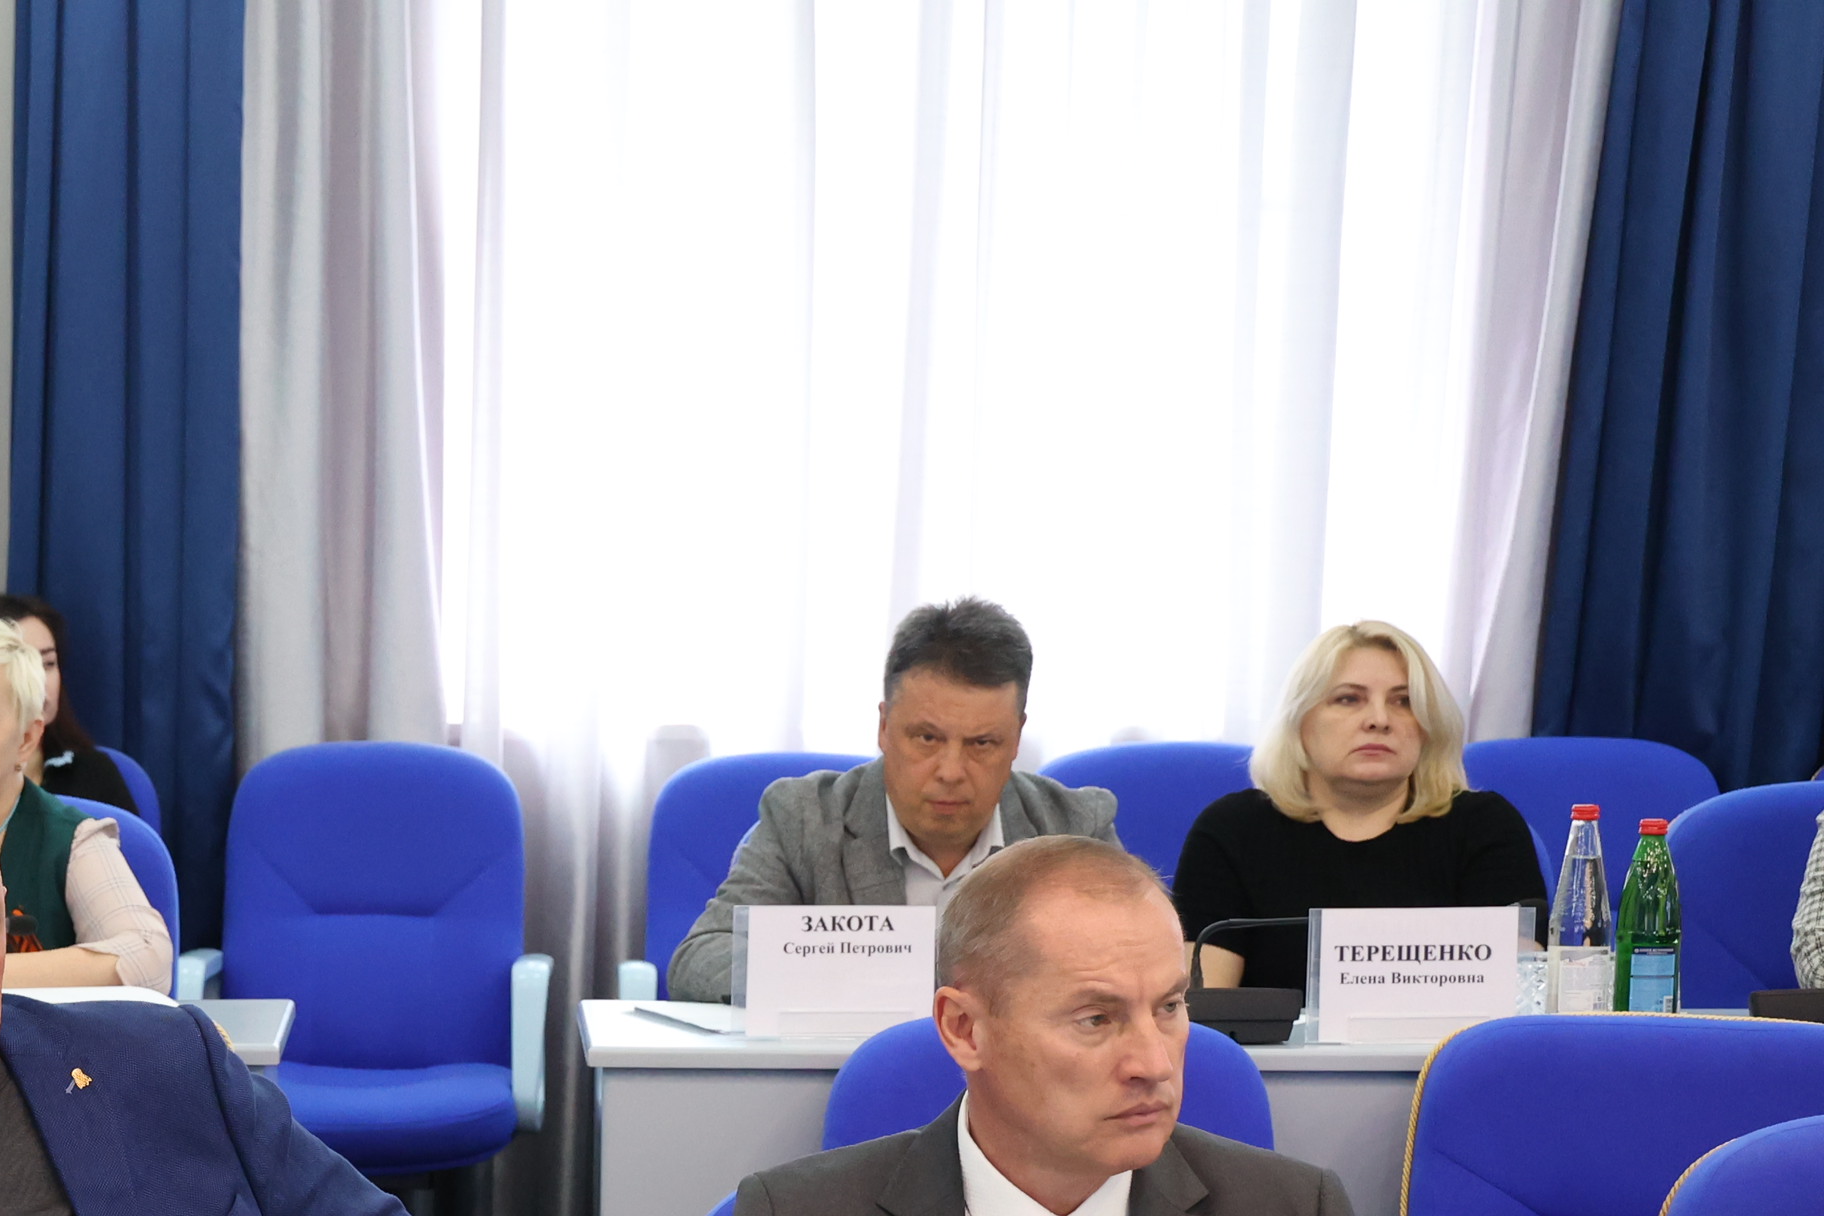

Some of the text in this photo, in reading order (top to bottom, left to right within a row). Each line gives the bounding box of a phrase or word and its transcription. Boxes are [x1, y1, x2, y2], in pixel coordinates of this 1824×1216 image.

[800, 914, 896, 933] ЗАКОТА
[782, 941, 913, 958] Сергей Петрович
[1333, 943, 1494, 965] ТЕРЕЩЕНКО
[1339, 971, 1485, 988] Елена Викторовна
